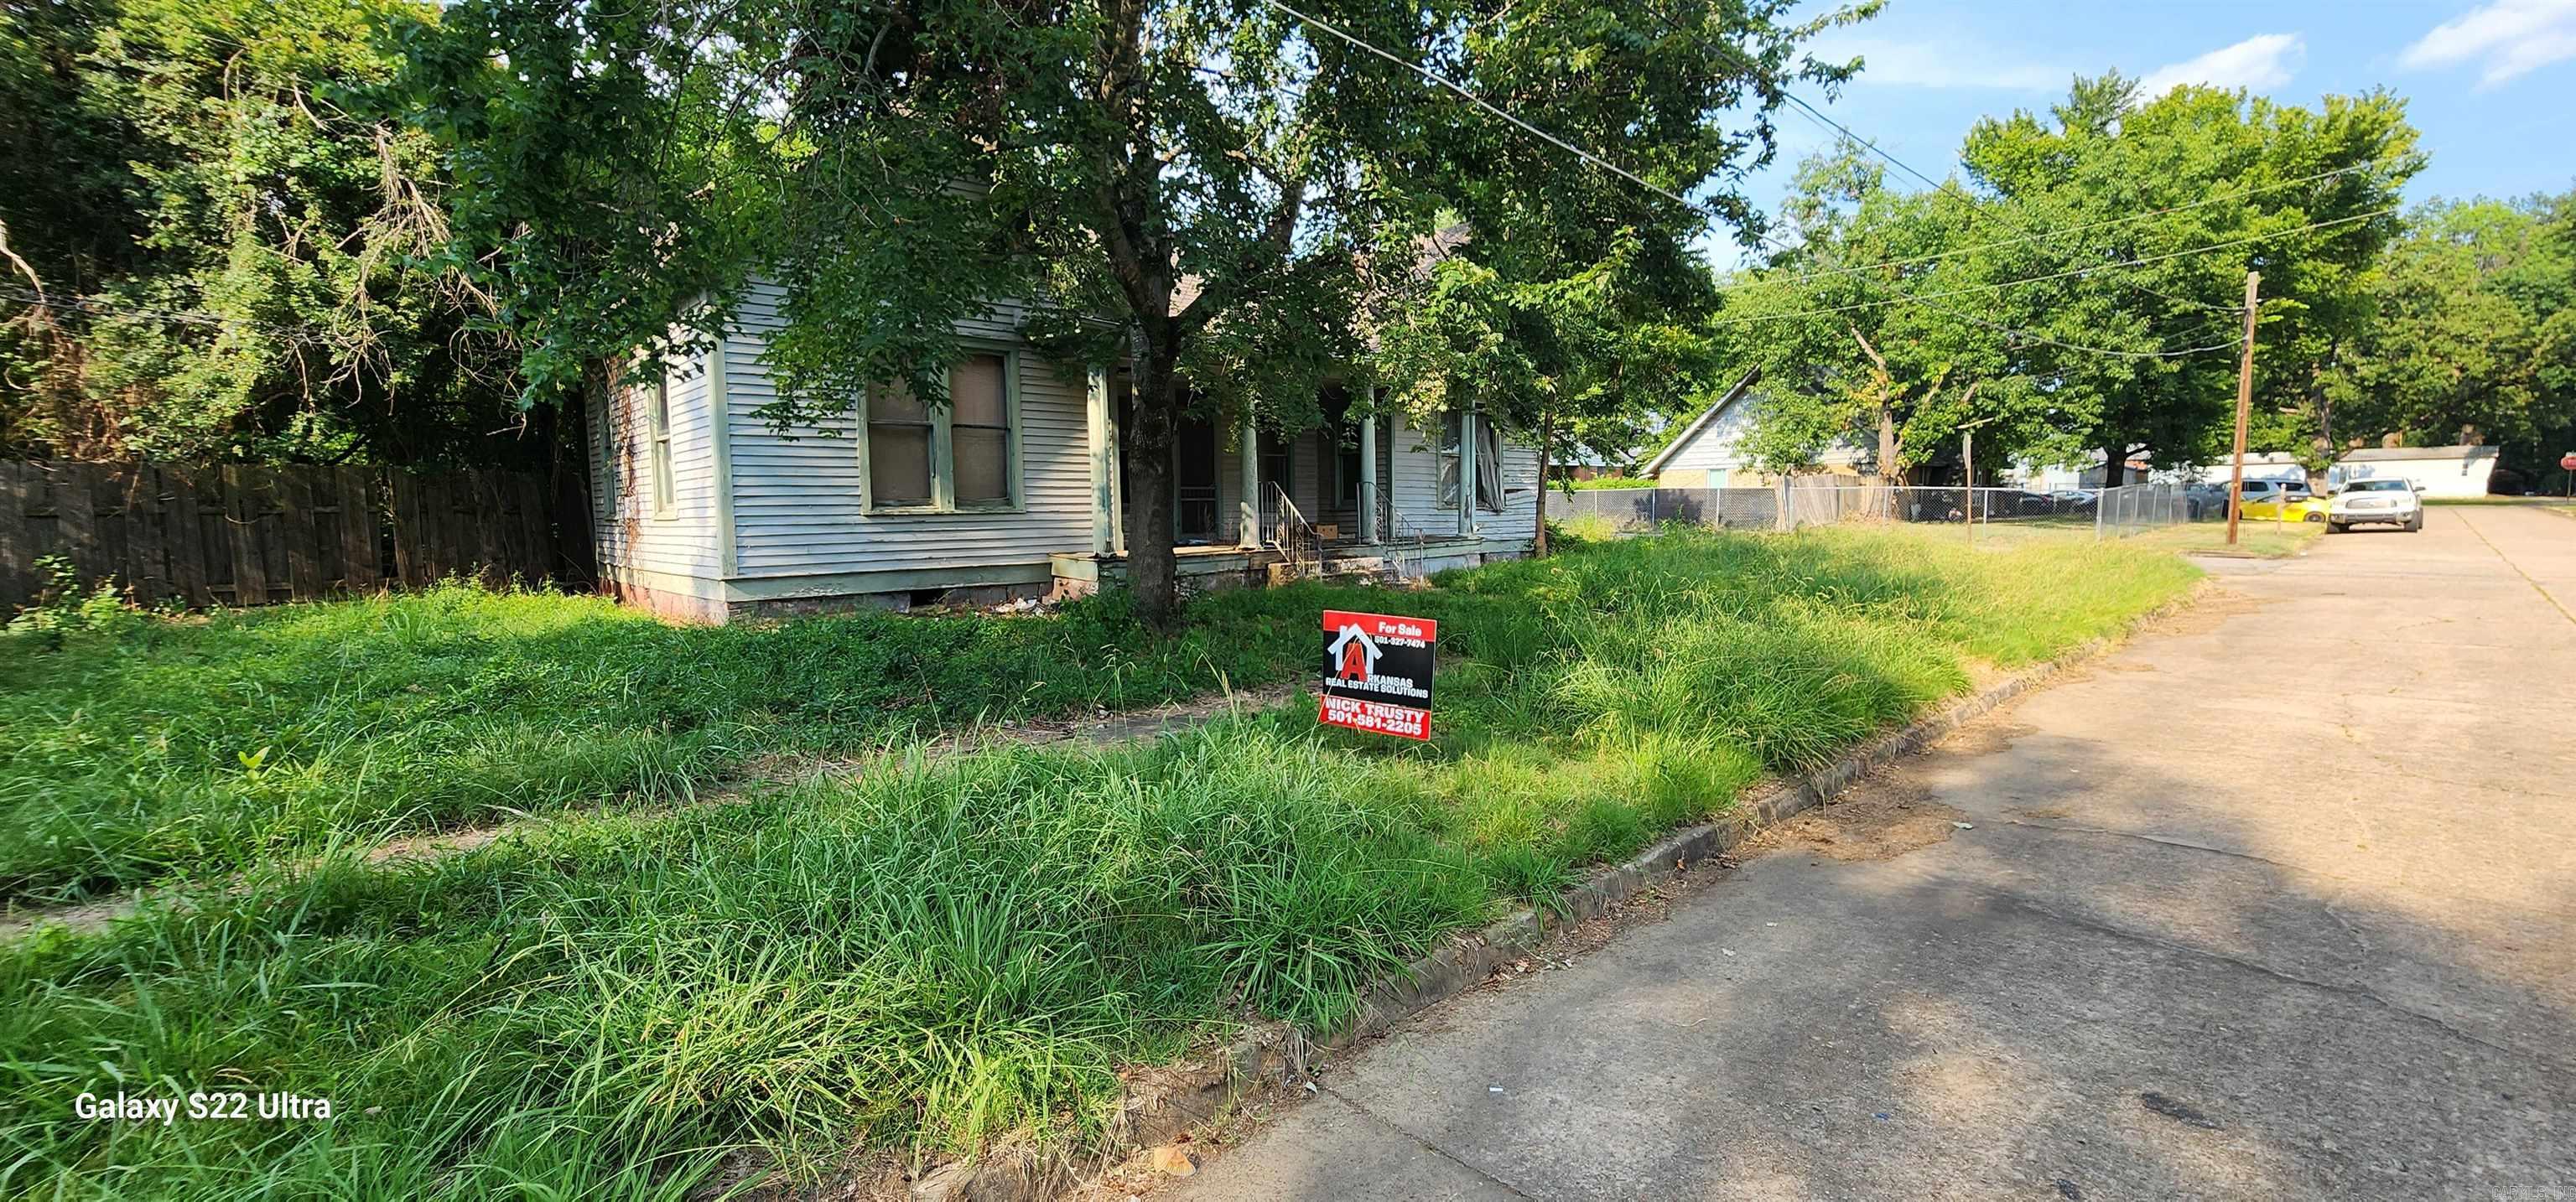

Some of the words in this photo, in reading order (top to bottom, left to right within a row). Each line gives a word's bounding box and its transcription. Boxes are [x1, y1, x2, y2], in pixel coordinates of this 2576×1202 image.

[1379, 622, 1396, 633] For
[1398, 624, 1422, 636] Sale
[1326, 677, 1347, 688] REAL
[1348, 681, 1379, 692] ESTATE
[1380, 684, 1429, 698] SOLUTIONS
[1326, 698, 1362, 713] NICK
[1364, 703, 1425, 723] TRUSTY
[1328, 710, 1422, 735] 501-581-2205
